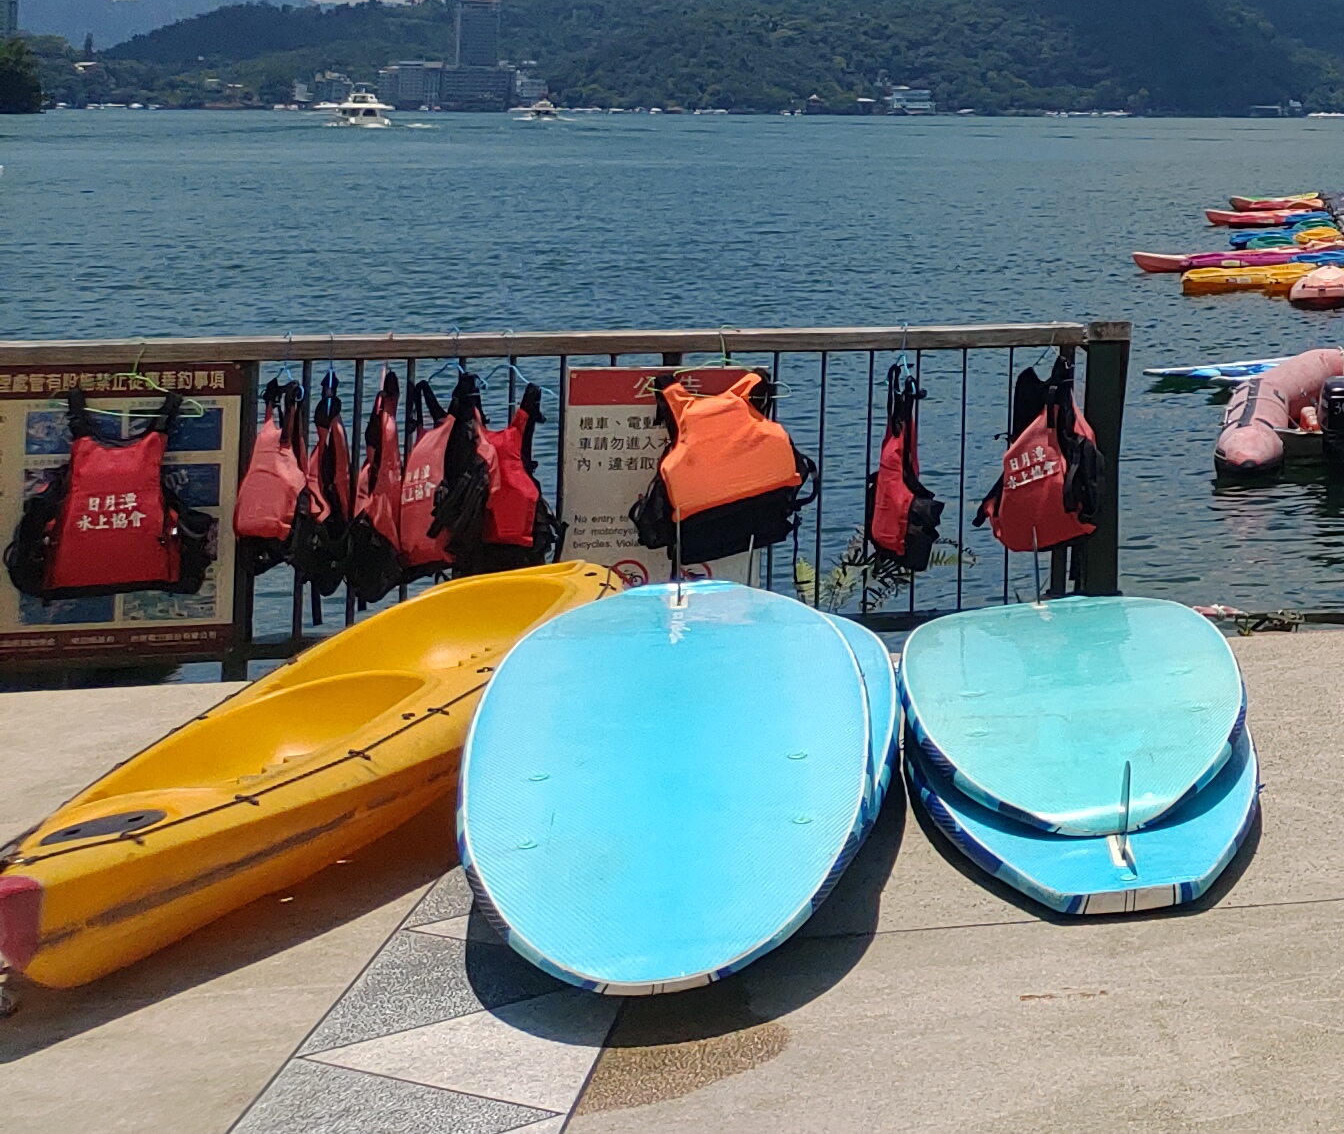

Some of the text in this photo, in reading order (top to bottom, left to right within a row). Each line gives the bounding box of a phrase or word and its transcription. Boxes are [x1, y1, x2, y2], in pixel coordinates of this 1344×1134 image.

[1009, 445, 1047, 471] 日月潭
[88, 492, 137, 512] 日月潭
[76, 510, 147, 531] 水上協會
[574, 514, 588, 524] No
[591, 515, 616, 525] entry
[573, 527, 586, 536] for
